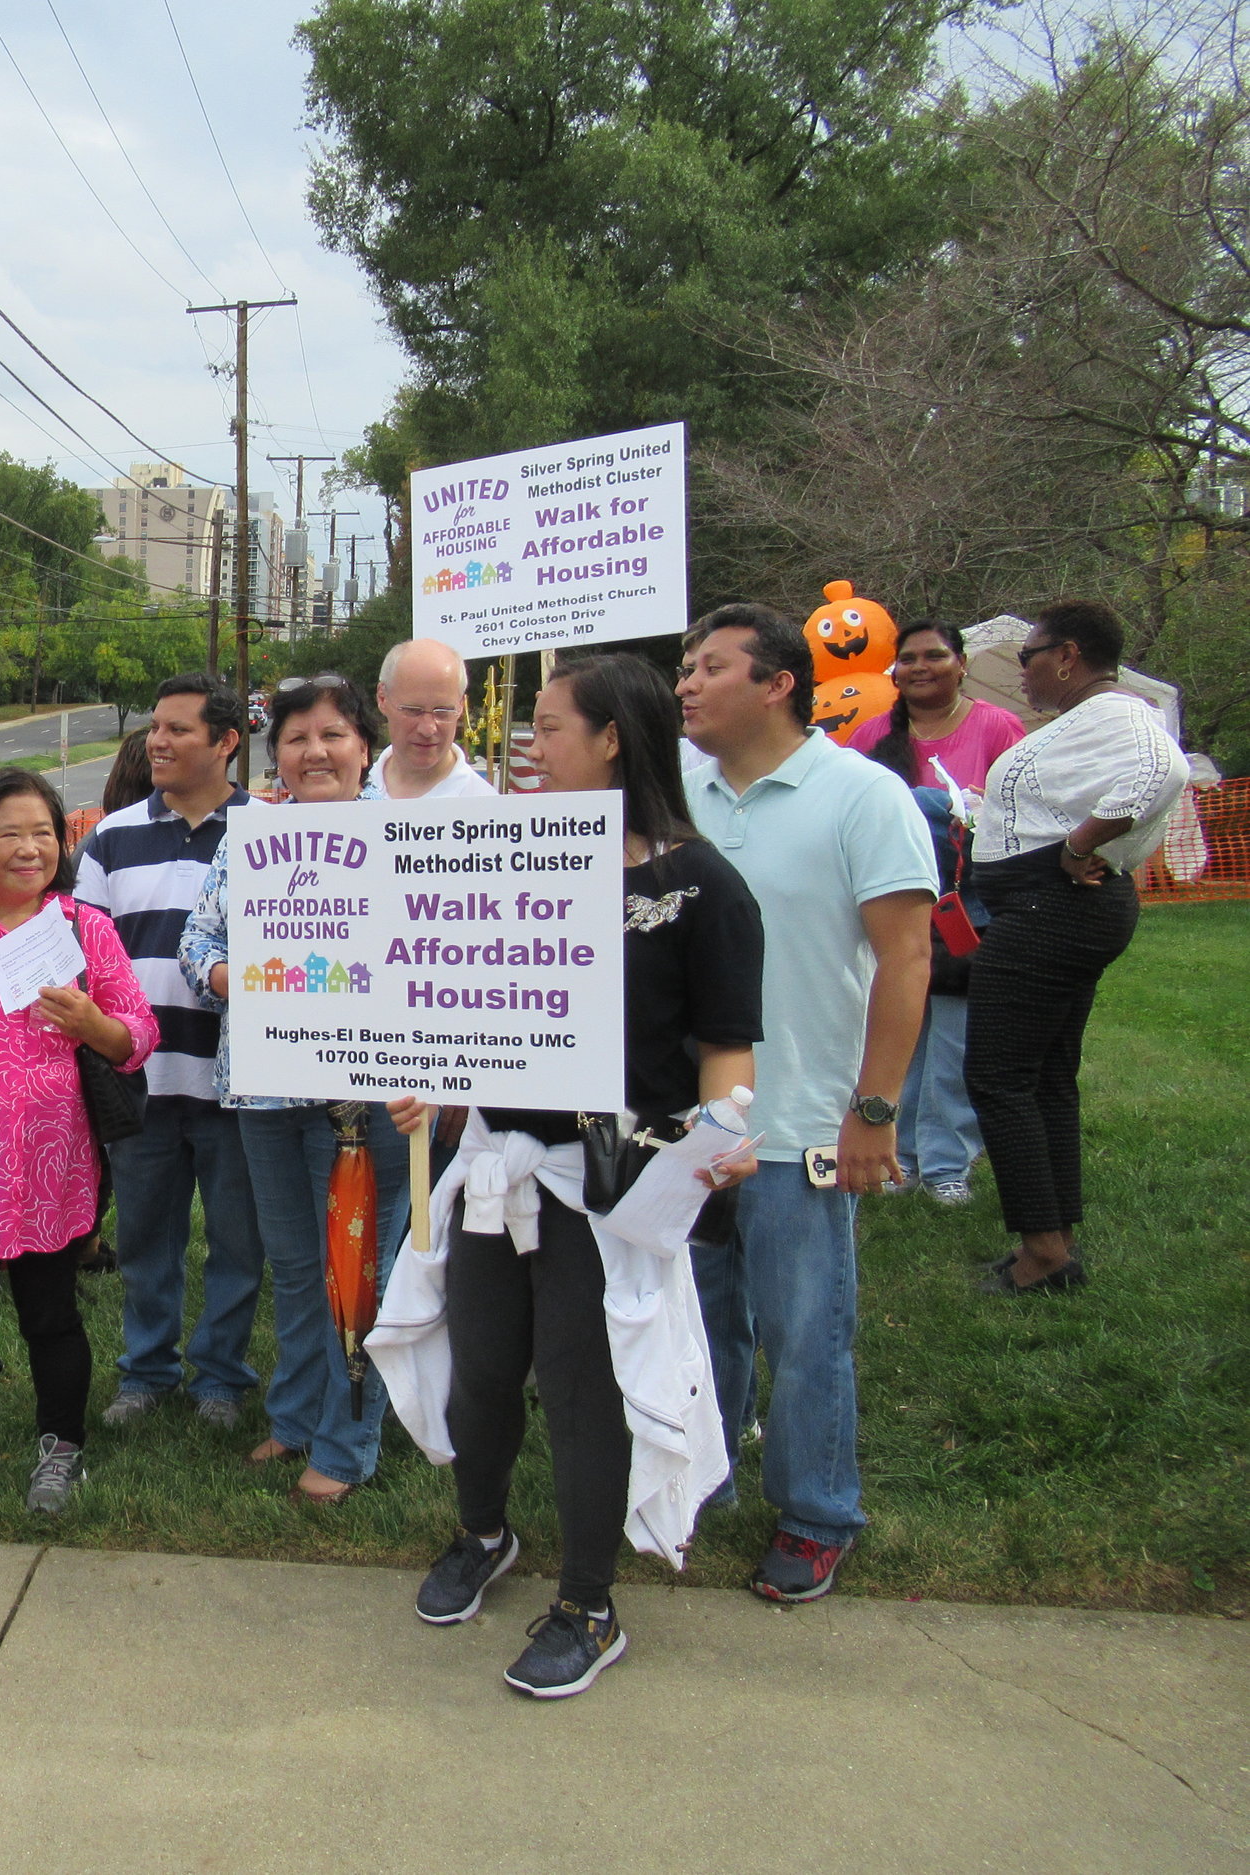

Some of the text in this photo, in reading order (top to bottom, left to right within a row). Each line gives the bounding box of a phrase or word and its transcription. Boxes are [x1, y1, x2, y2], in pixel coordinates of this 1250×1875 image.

[520, 440, 671, 478] Silver Spring United
[423, 478, 509, 513] UNITED
[528, 466, 662, 499] Methodist Cluster
[453, 504, 475, 526] for
[535, 497, 648, 528] Walk for
[423, 518, 510, 545] AFFORDABLE
[521, 523, 664, 559] Affordable
[436, 536, 497, 557] HOUSING
[537, 556, 647, 585] Housing
[441, 585, 656, 624] St. Paul United Methodist Church
[475, 608, 605, 633] 2601 Coloston Drive
[482, 624, 594, 647] Chevy Chase, MD
[384, 815, 606, 844] Silver Spring United
[244, 831, 367, 871] UNITED
[394, 852, 593, 874] Methodist Cluster
[288, 864, 319, 897] for
[244, 898, 369, 916] AFFORDABLE
[405, 892, 573, 921] Walk for
[263, 921, 349, 940] HOUSING
[385, 937, 595, 966] Affordable
[407, 981, 569, 1018] Housing
[265, 1027, 575, 1048] Hughes-El Buen Samaritano UMC
[316, 1050, 526, 1070] 10700 Georgia Avenue
[349, 1073, 471, 1091] Wheaton, MD
